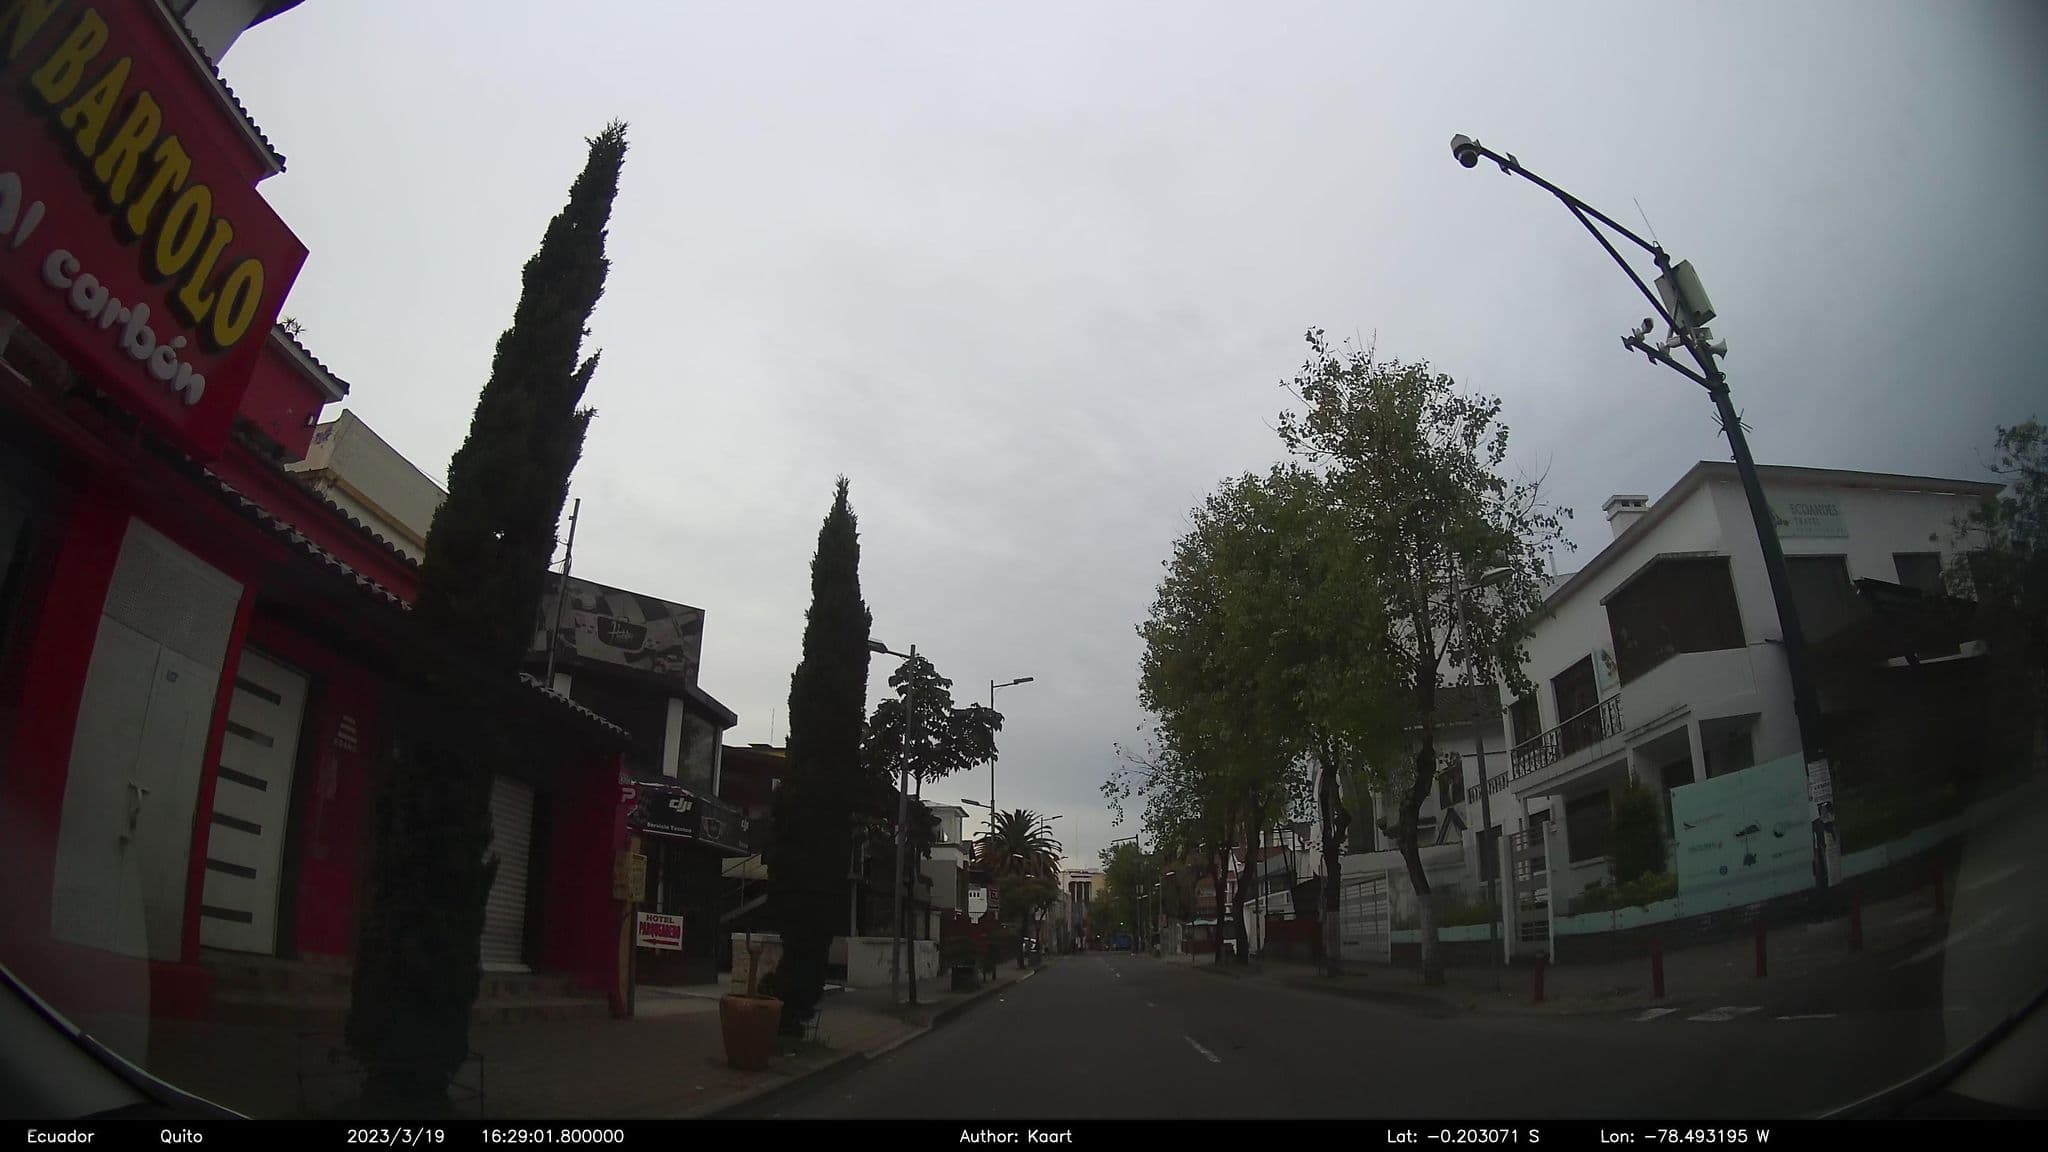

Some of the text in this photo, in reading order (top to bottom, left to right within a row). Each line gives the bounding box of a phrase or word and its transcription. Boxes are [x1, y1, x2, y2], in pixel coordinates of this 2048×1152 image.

[31, 8, 265, 348] BARTOLO
[42, 249, 206, 406] carbón
[646, 914, 674, 923] HOTEL
